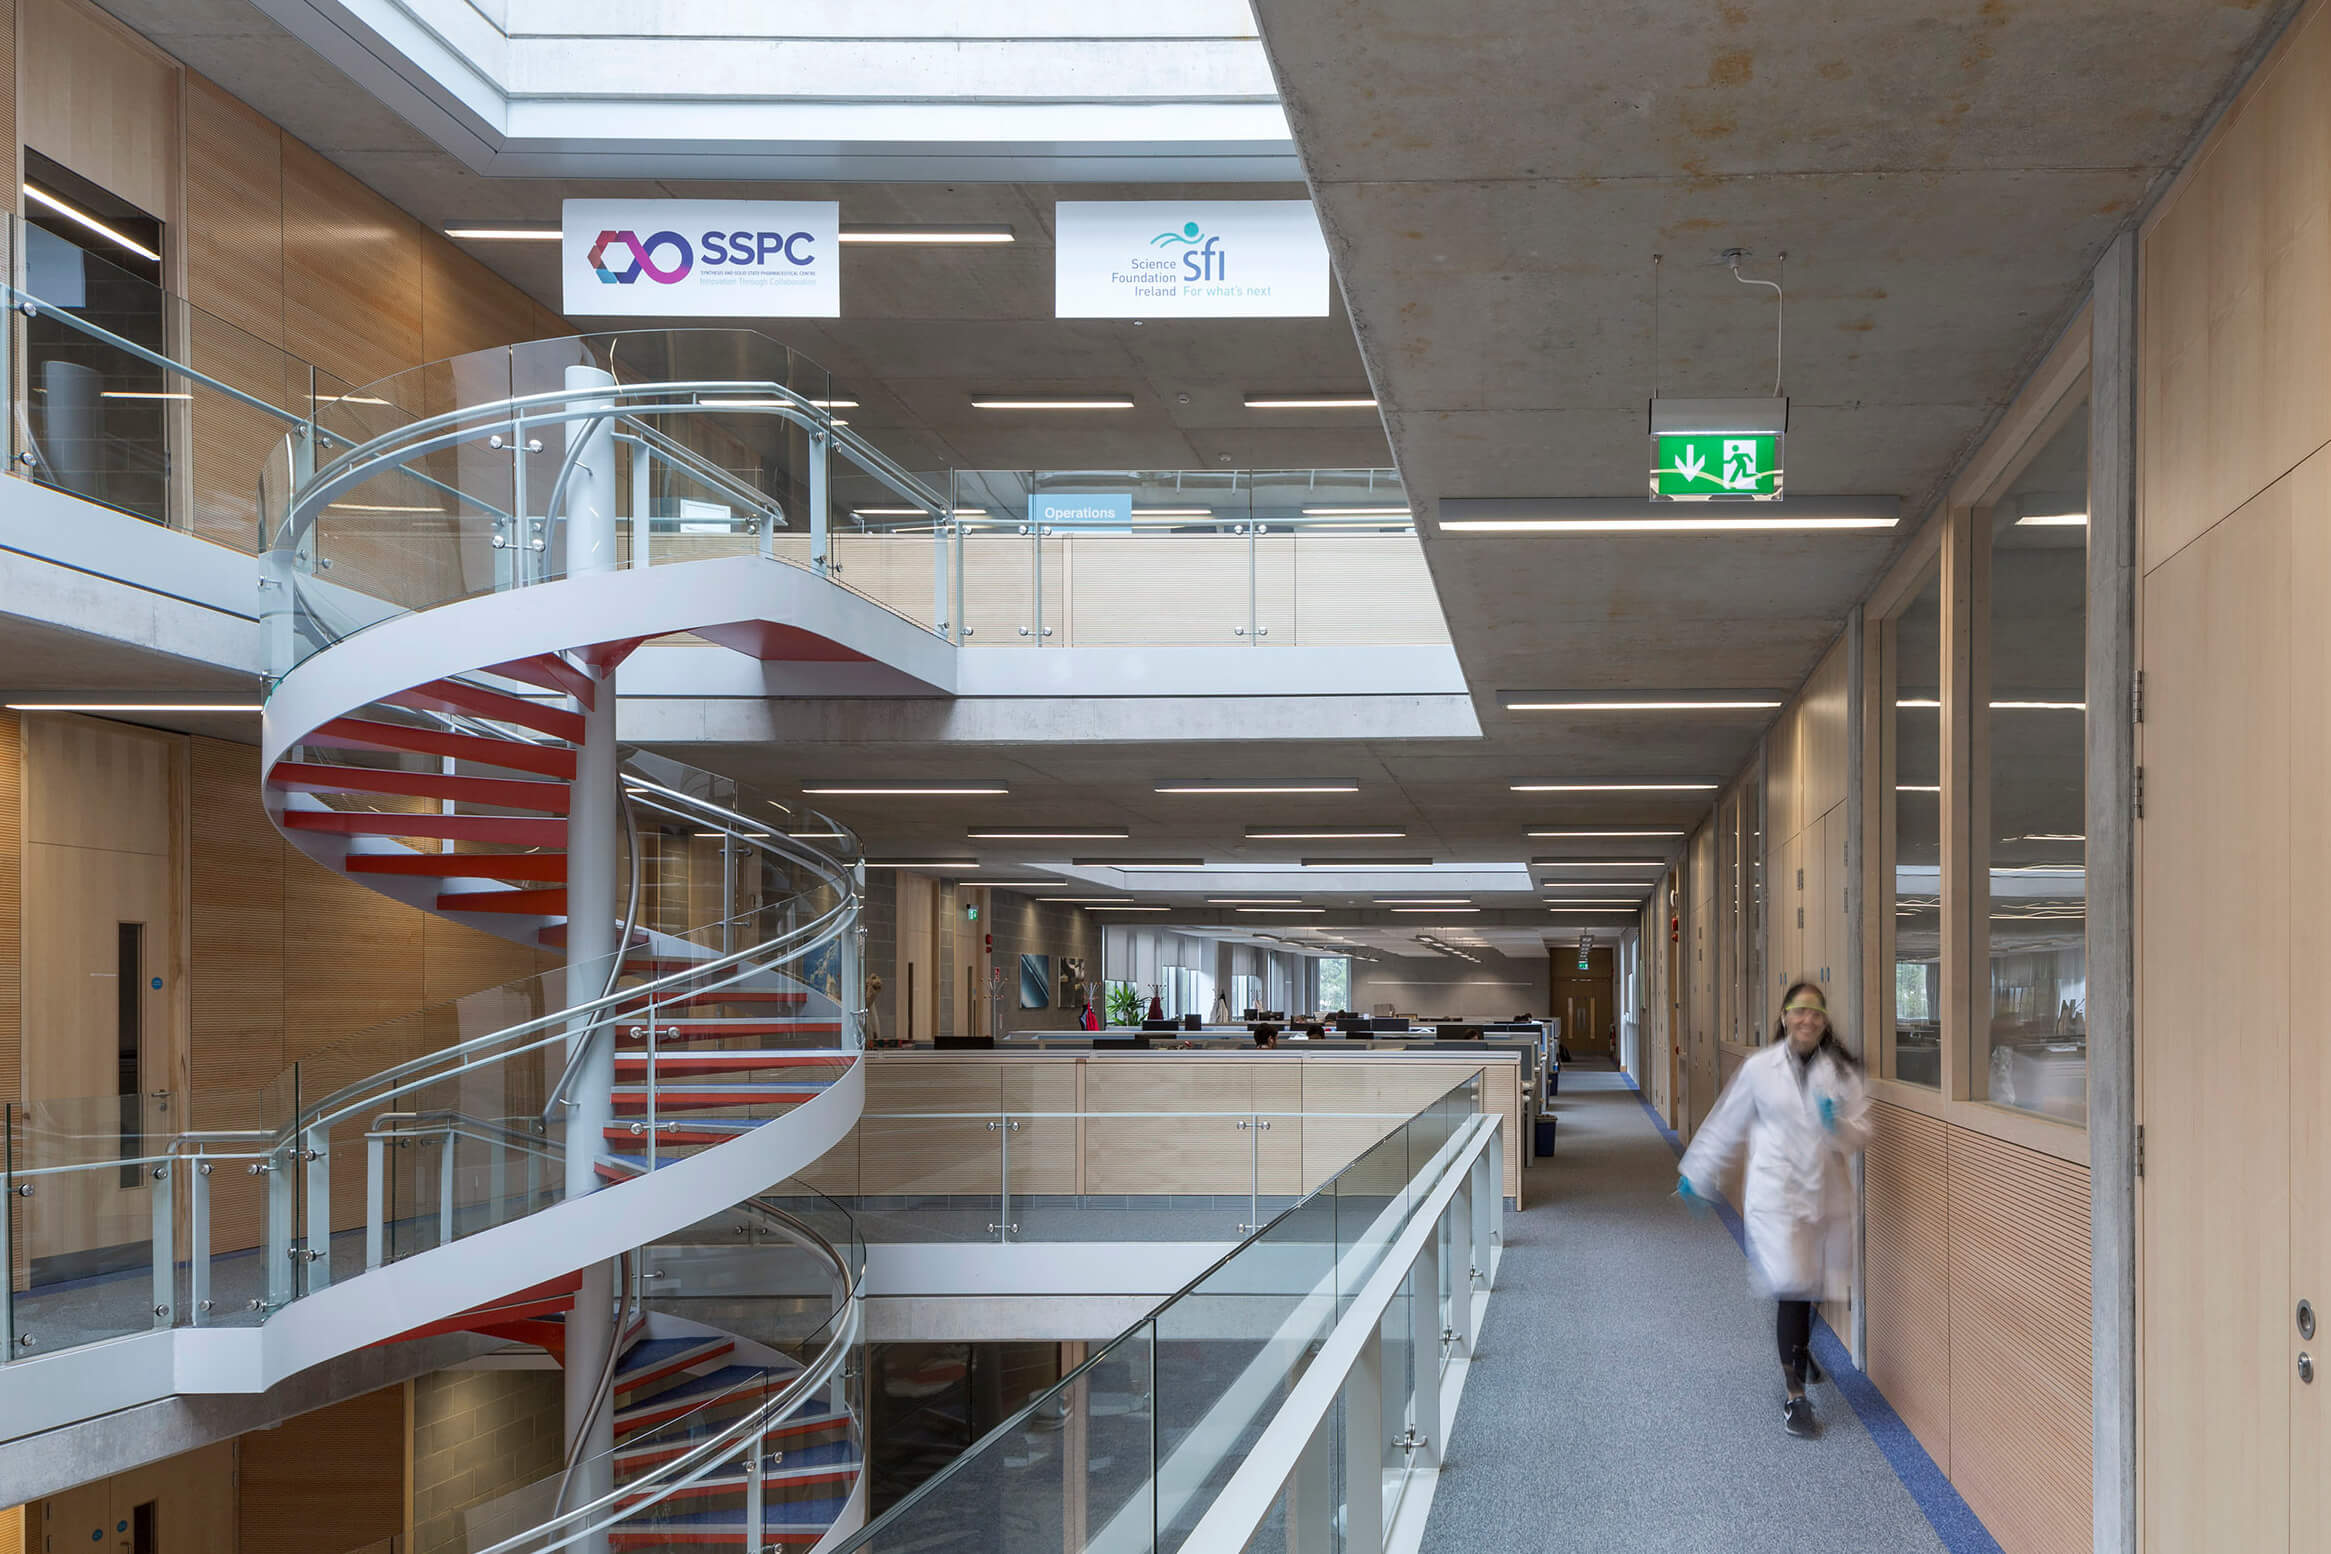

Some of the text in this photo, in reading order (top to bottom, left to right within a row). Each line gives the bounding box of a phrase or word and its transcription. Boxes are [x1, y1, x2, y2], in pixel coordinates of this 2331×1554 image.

[700, 231, 815, 266] SSPC
[1131, 258, 1177, 270] Science
[1111, 272, 1177, 284] Foundation
[1134, 286, 1177, 297] Ireland
[1183, 286, 1272, 297] For what's next
[1044, 507, 1116, 521] Operations
